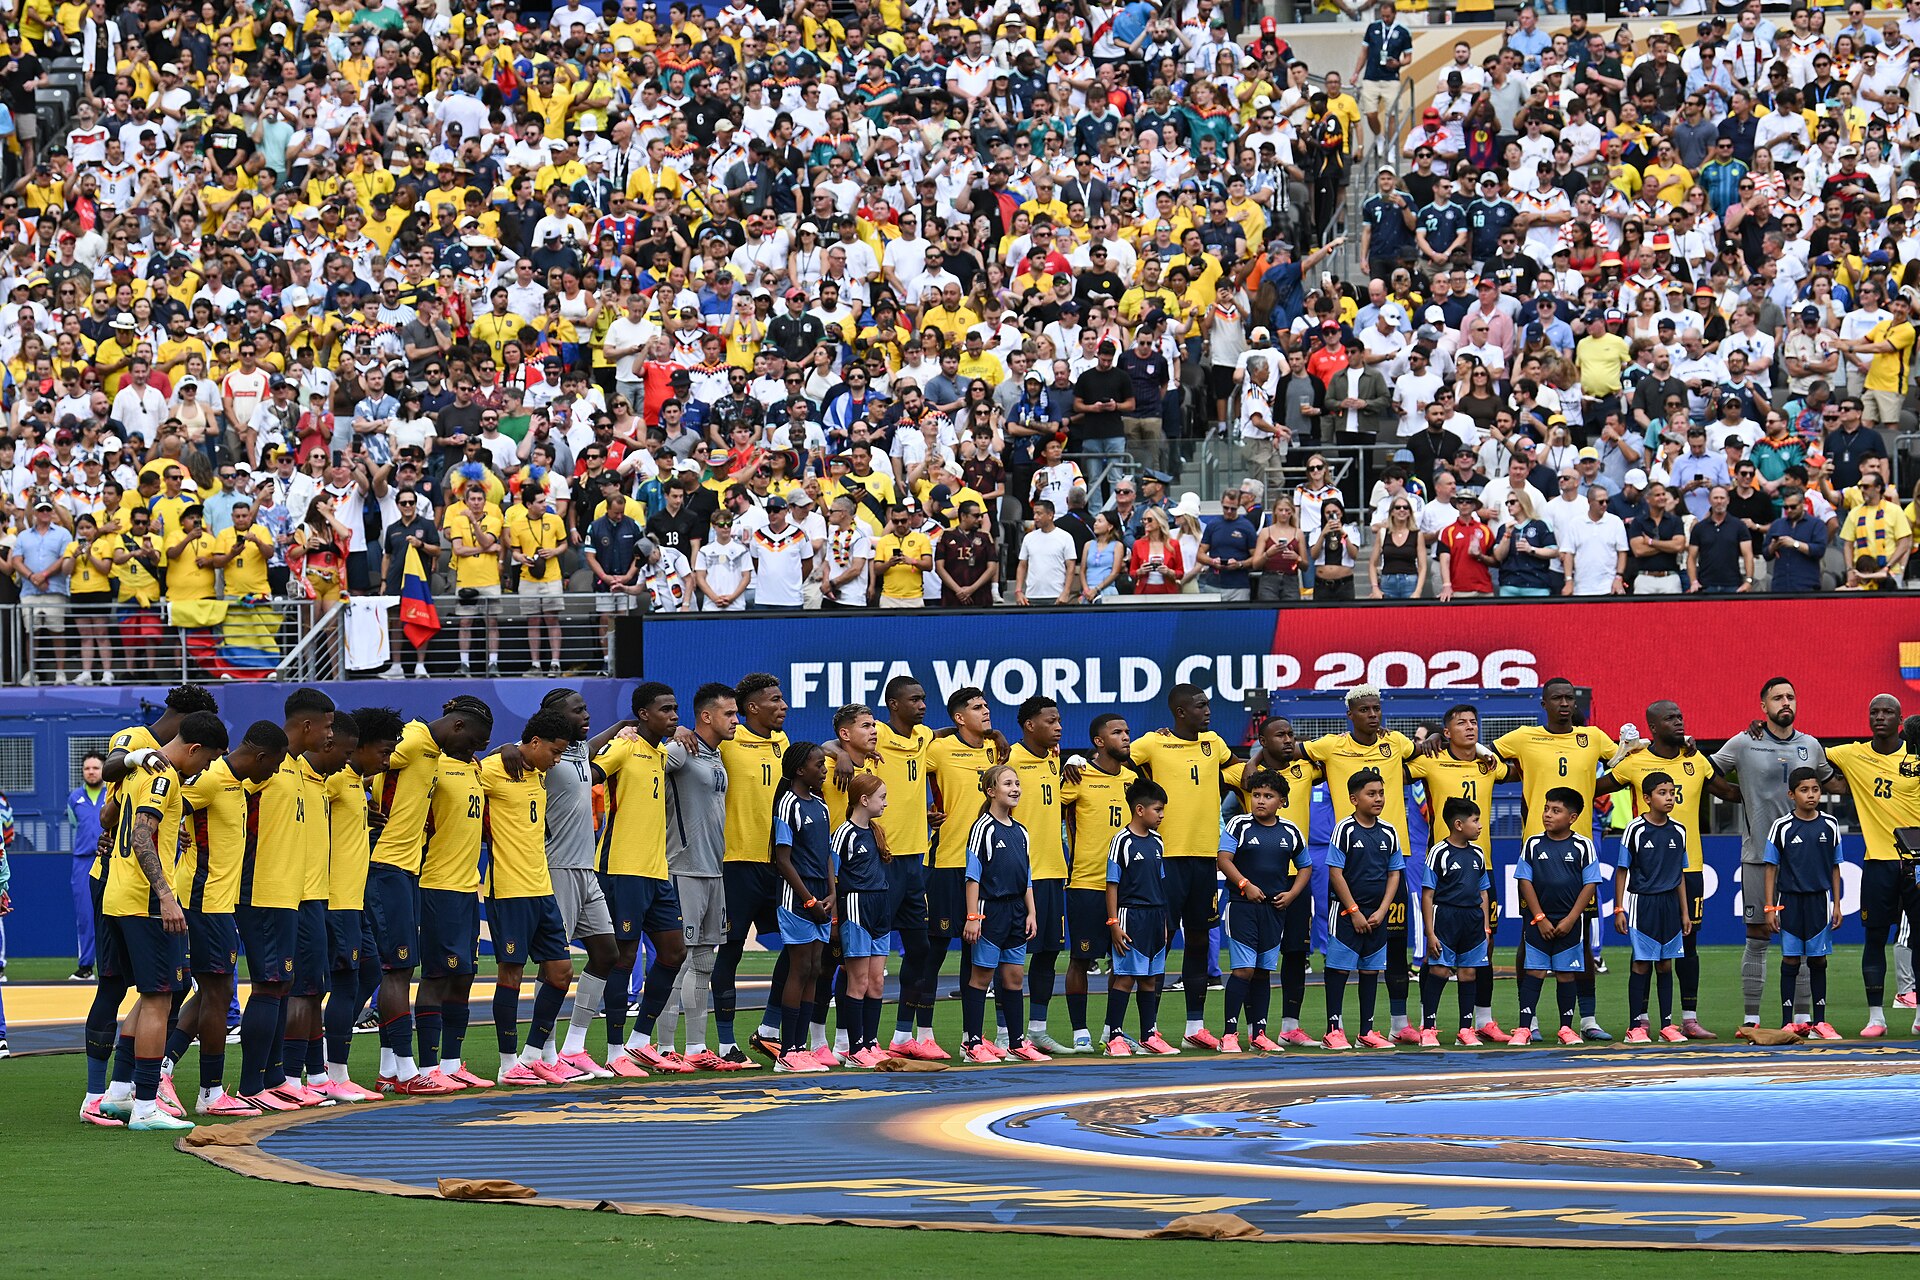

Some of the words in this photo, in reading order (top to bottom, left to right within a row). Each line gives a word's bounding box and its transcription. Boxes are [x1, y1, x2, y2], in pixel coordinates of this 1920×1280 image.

[696, 113, 705, 125] 6
[109, 183, 116, 194] 6
[1374, 211, 1382, 223] 7
[976, 475, 983, 487] 7
[1050, 481, 1061, 491] 17
[665, 531, 679, 545] 18
[957, 546, 973, 560] 13
[790, 660, 914, 708] FIFA
[932, 657, 1162, 708] WORLD
[1175, 653, 1301, 702] CUP
[1313, 649, 1539, 690] 2026
[573, 761, 588, 782] 12
[761, 763, 771, 786] 11
[906, 759, 917, 781] 18
[1190, 764, 1199, 785] 4
[1558, 757, 1568, 777] 6
[1781, 763, 1788, 783] 1
[653, 776, 658, 799] 2
[713, 769, 727, 793] 22
[1462, 780, 1476, 801] 21
[1874, 777, 1893, 799] 23
[1041, 783, 1052, 805] 19
[1674, 784, 1683, 804] 3
[467, 794, 480, 819] 26
[529, 800, 538, 823] 8
[1109, 805, 1122, 828] 15
[1387, 902, 1405, 924] 20
[1490, 901, 1498, 924] 2
